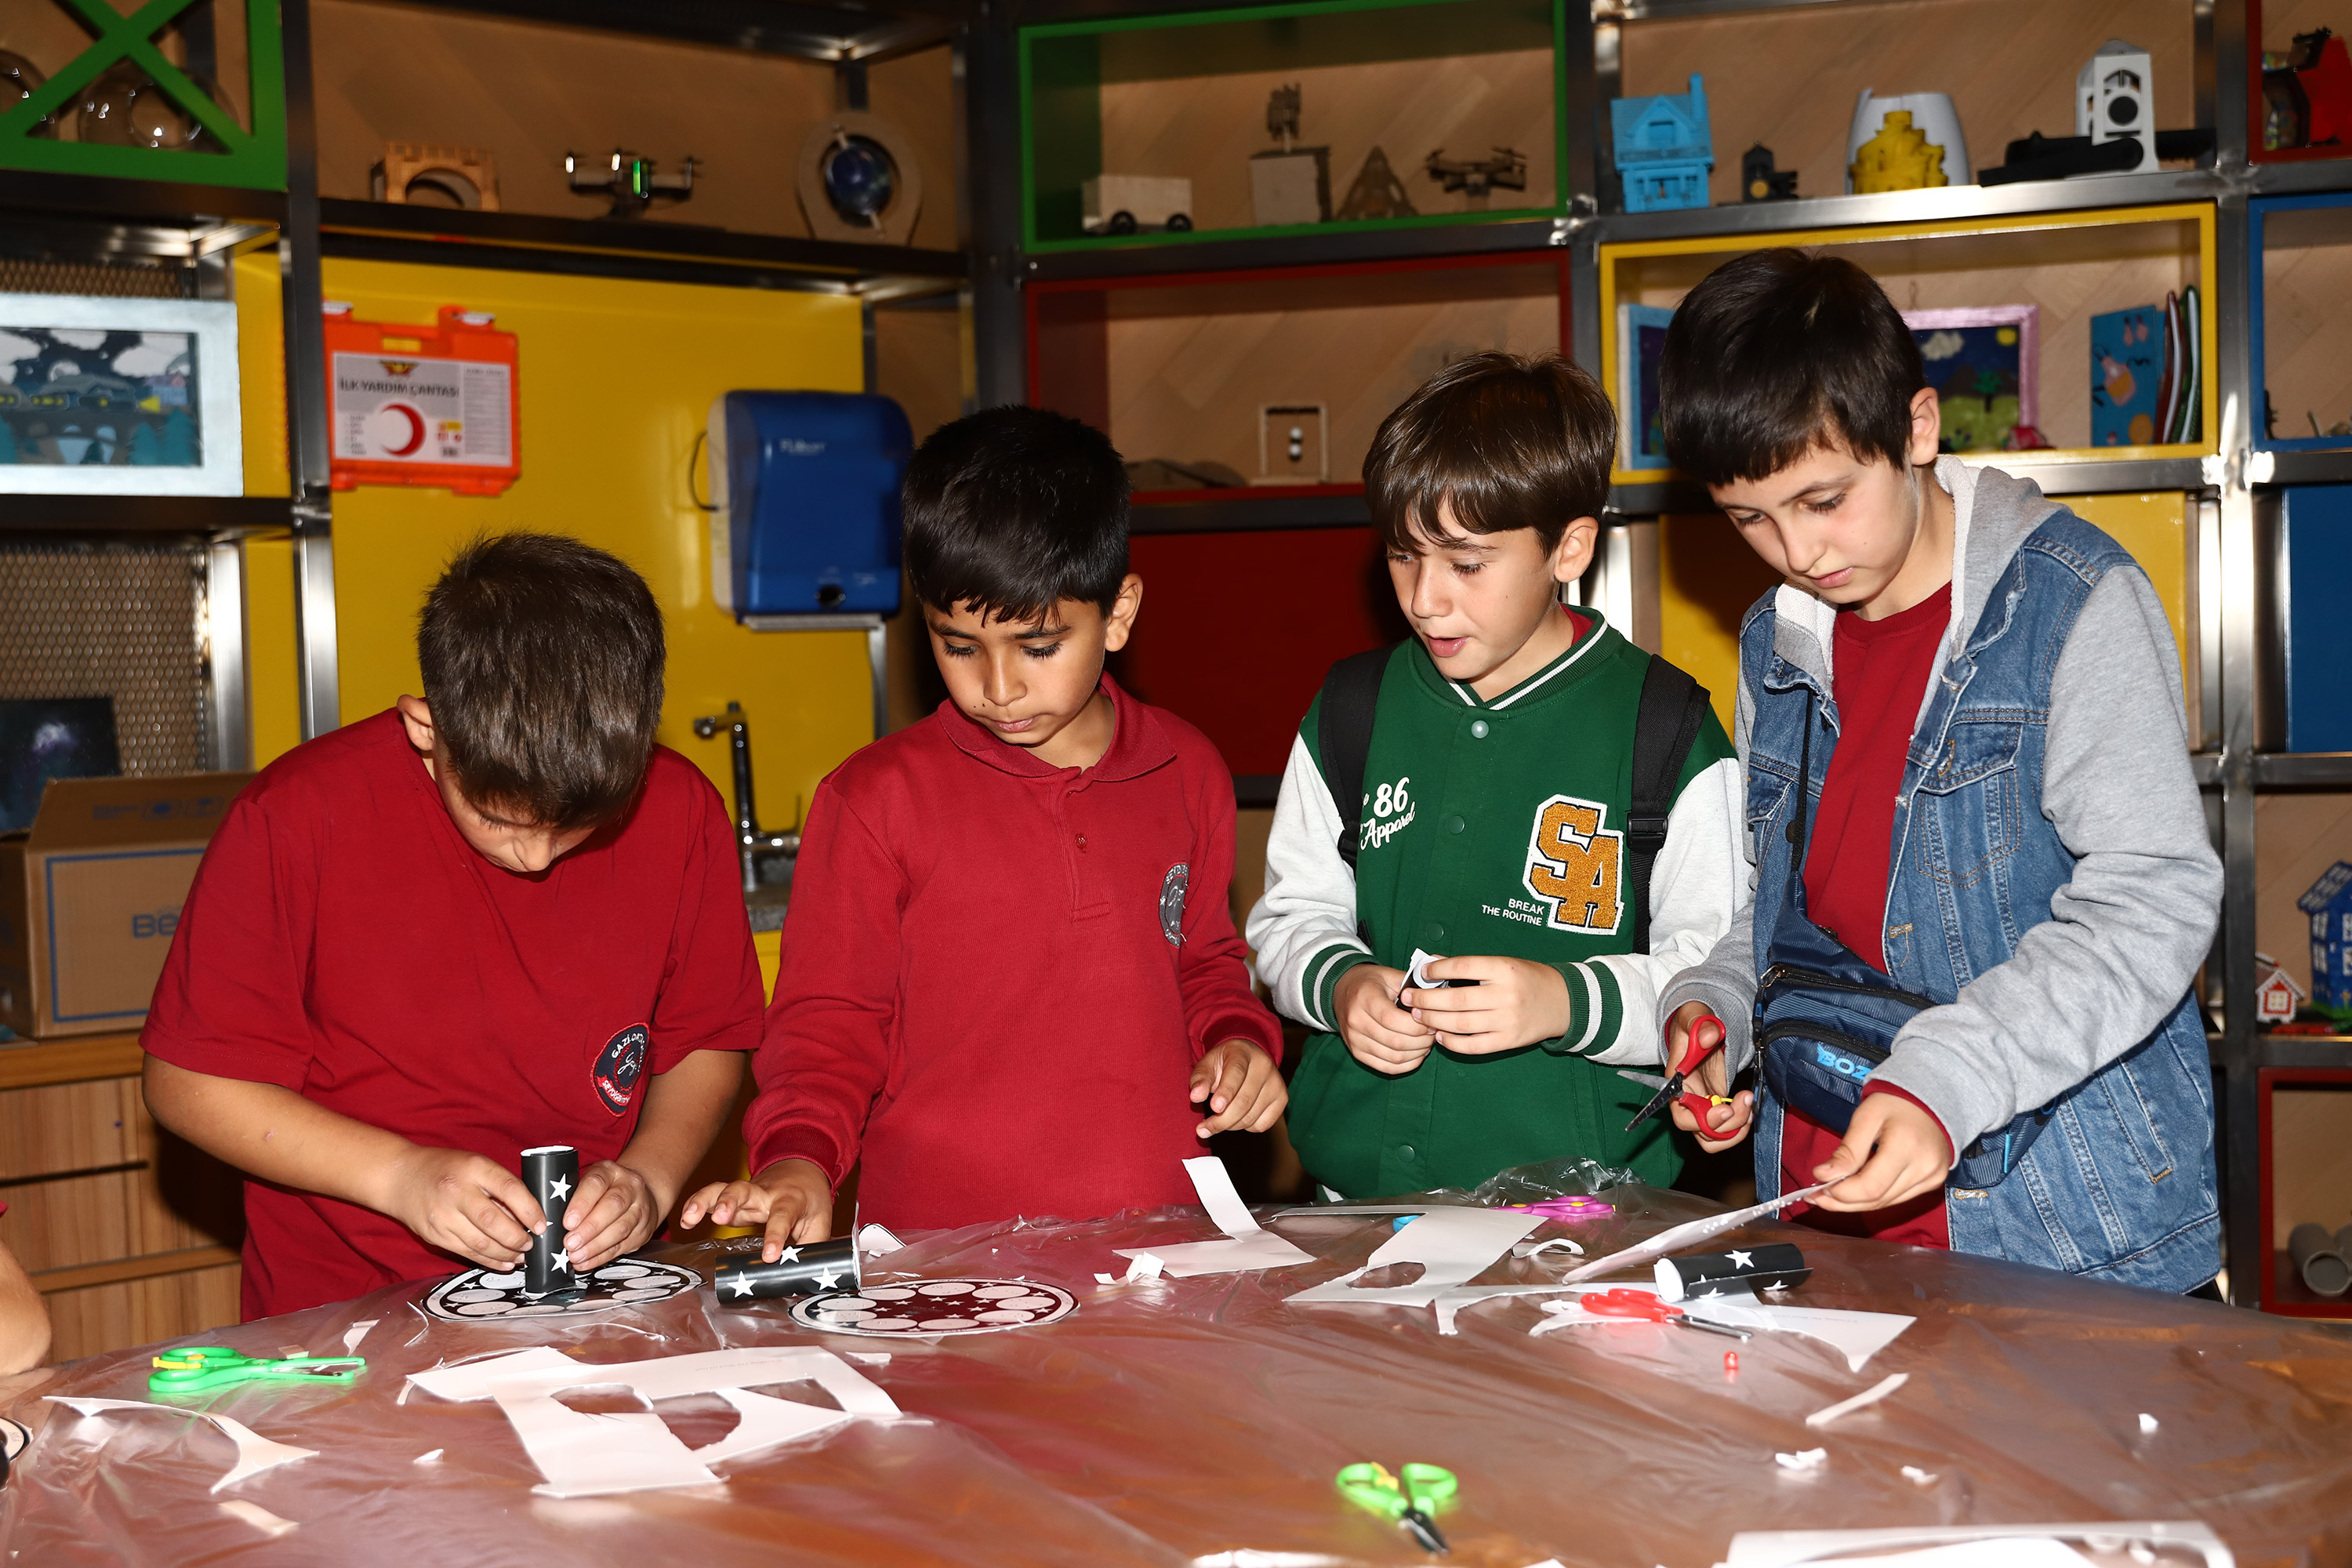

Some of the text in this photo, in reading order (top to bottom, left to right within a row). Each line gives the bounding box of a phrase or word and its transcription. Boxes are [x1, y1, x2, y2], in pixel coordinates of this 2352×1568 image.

[340, 376, 460, 398] İLK YARDIM ÇANTASI
[1360, 801, 1416, 851] Apparel
[1527, 798, 1621, 931] SA
[1481, 904, 1543, 927] THE ROUTINE
[1508, 898, 1545, 916] BREAK
